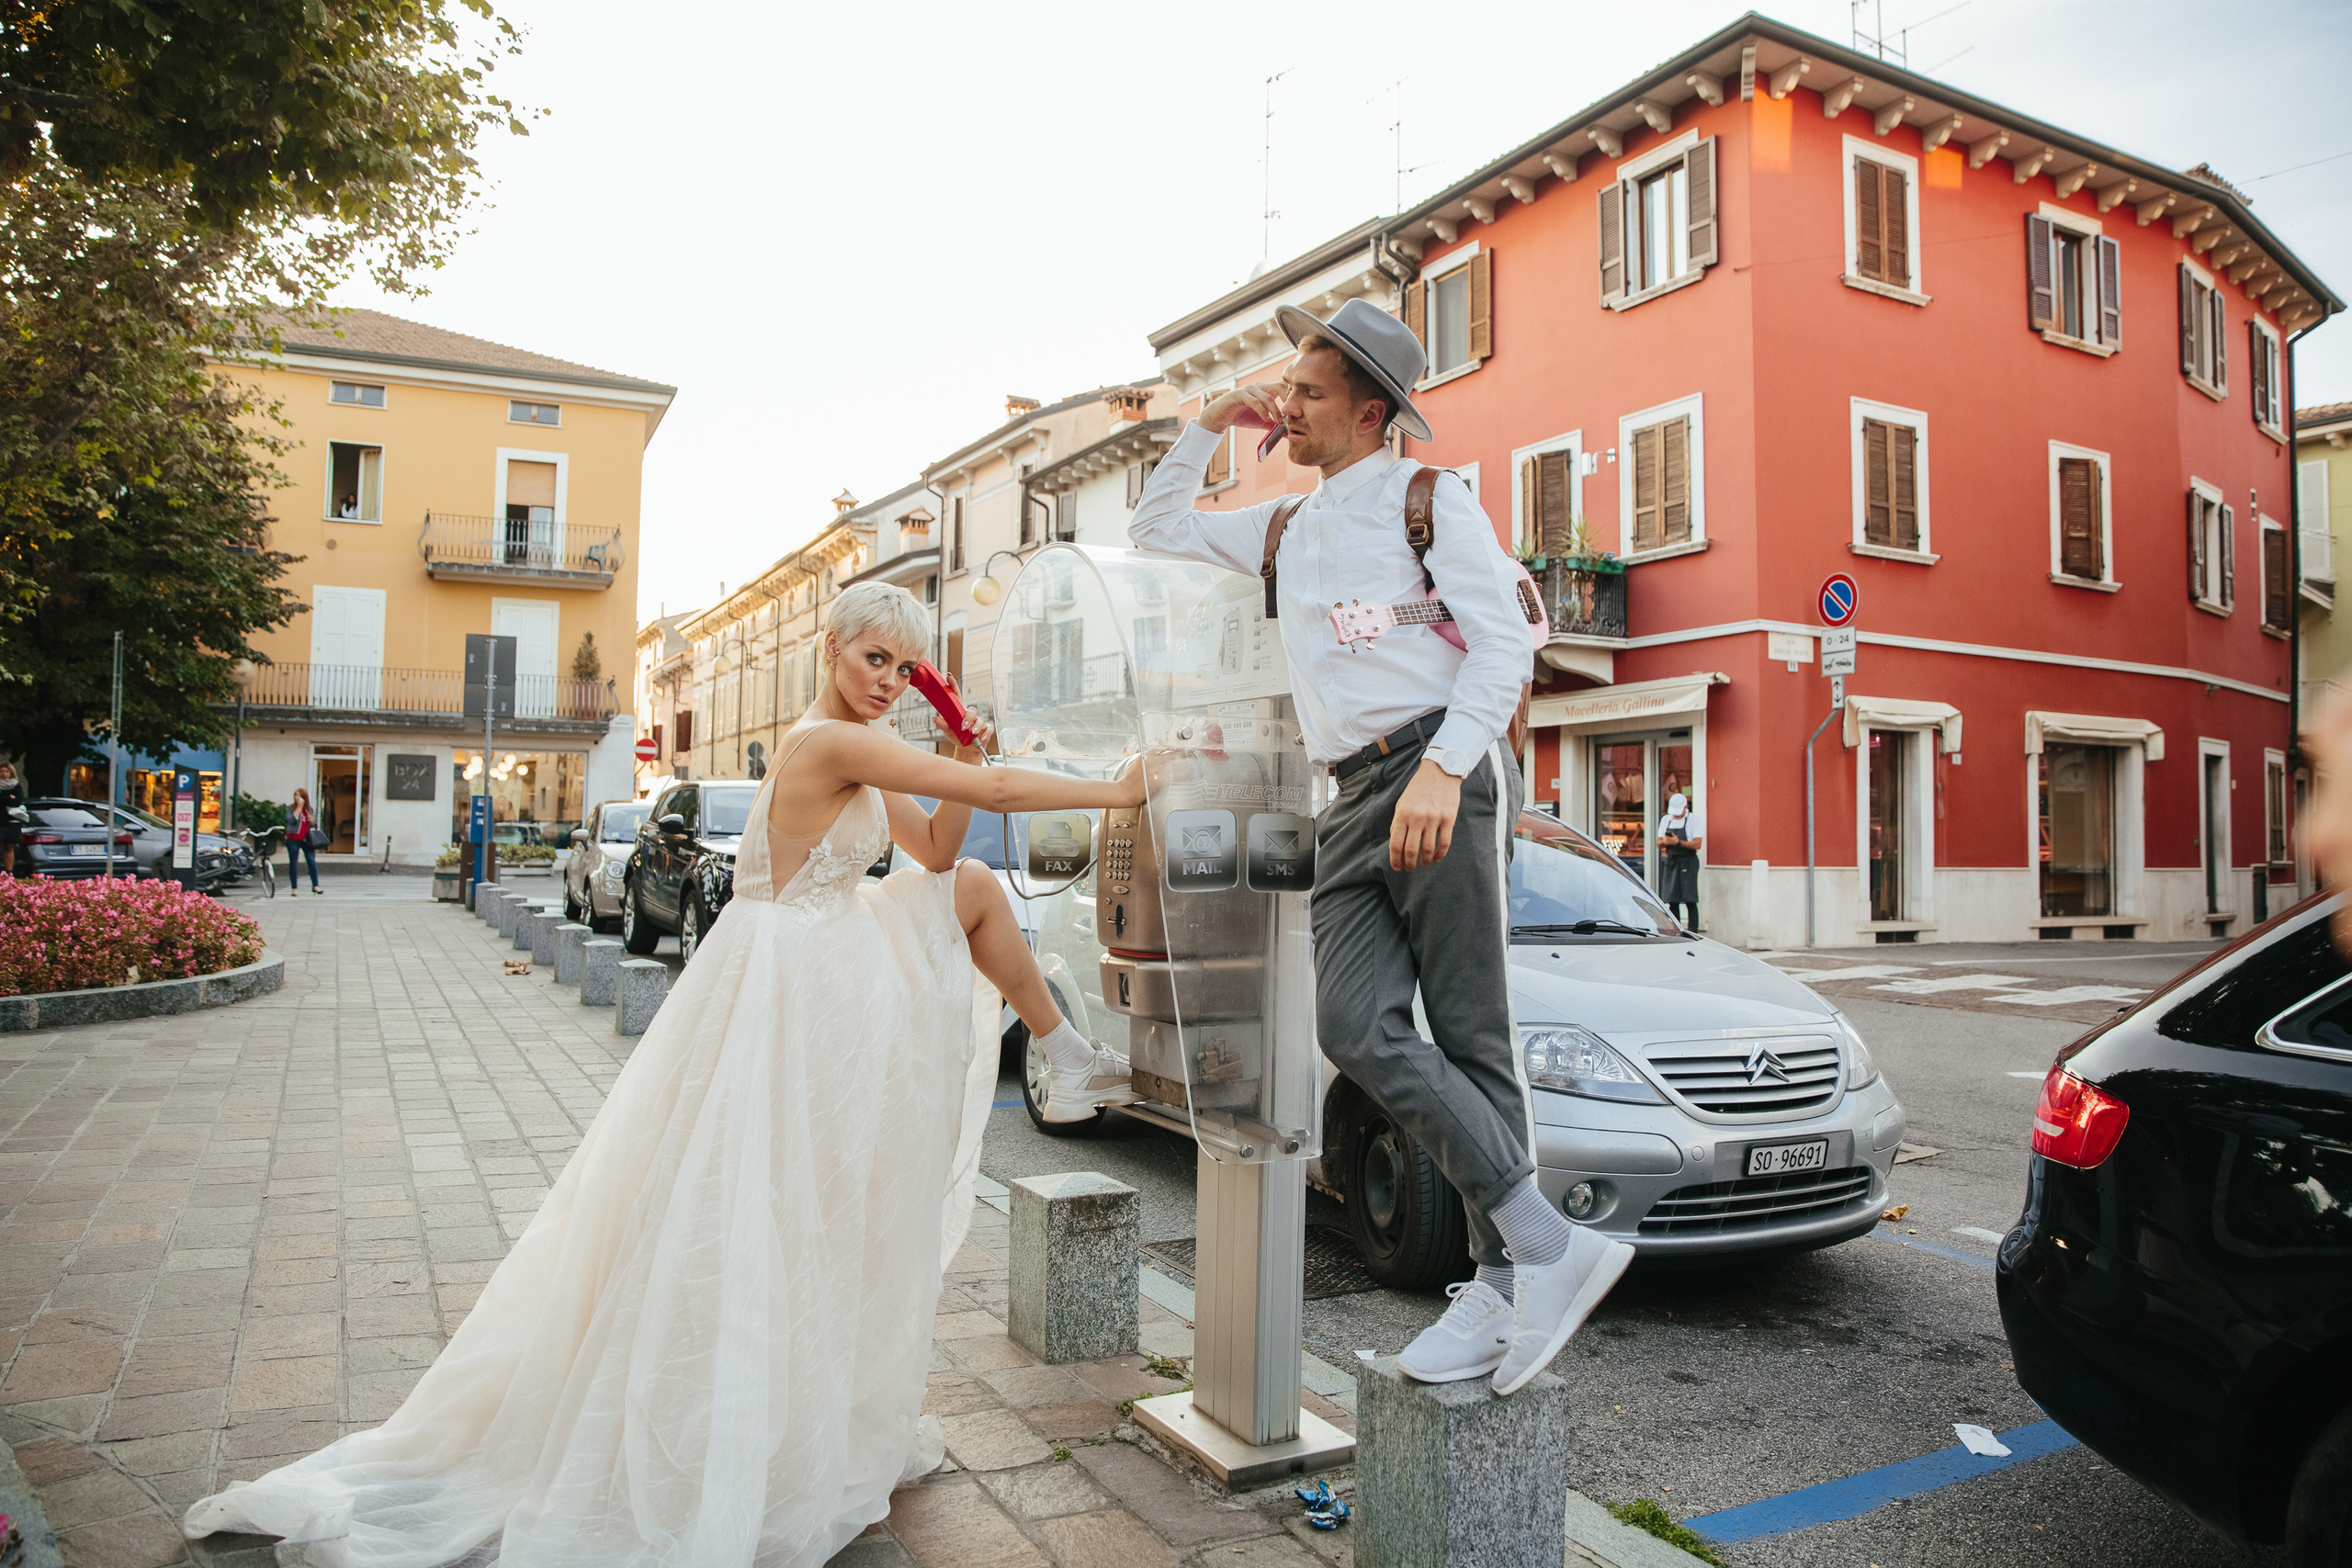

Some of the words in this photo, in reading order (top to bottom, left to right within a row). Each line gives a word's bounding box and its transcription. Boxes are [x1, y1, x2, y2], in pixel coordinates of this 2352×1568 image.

[1826, 637, 1833, 646] 0
[1838, 635, 1849, 644] 24
[1565, 701, 1619, 717] Macelleria
[1623, 696, 1665, 714] Gallina
[394, 762, 431, 777] BOX
[178, 774, 190, 788] P
[1218, 784, 1305, 801] TELECOM
[1045, 860, 1073, 872] FAX
[1182, 862, 1223, 875] MAIL
[1266, 863, 1295, 876] SMS
